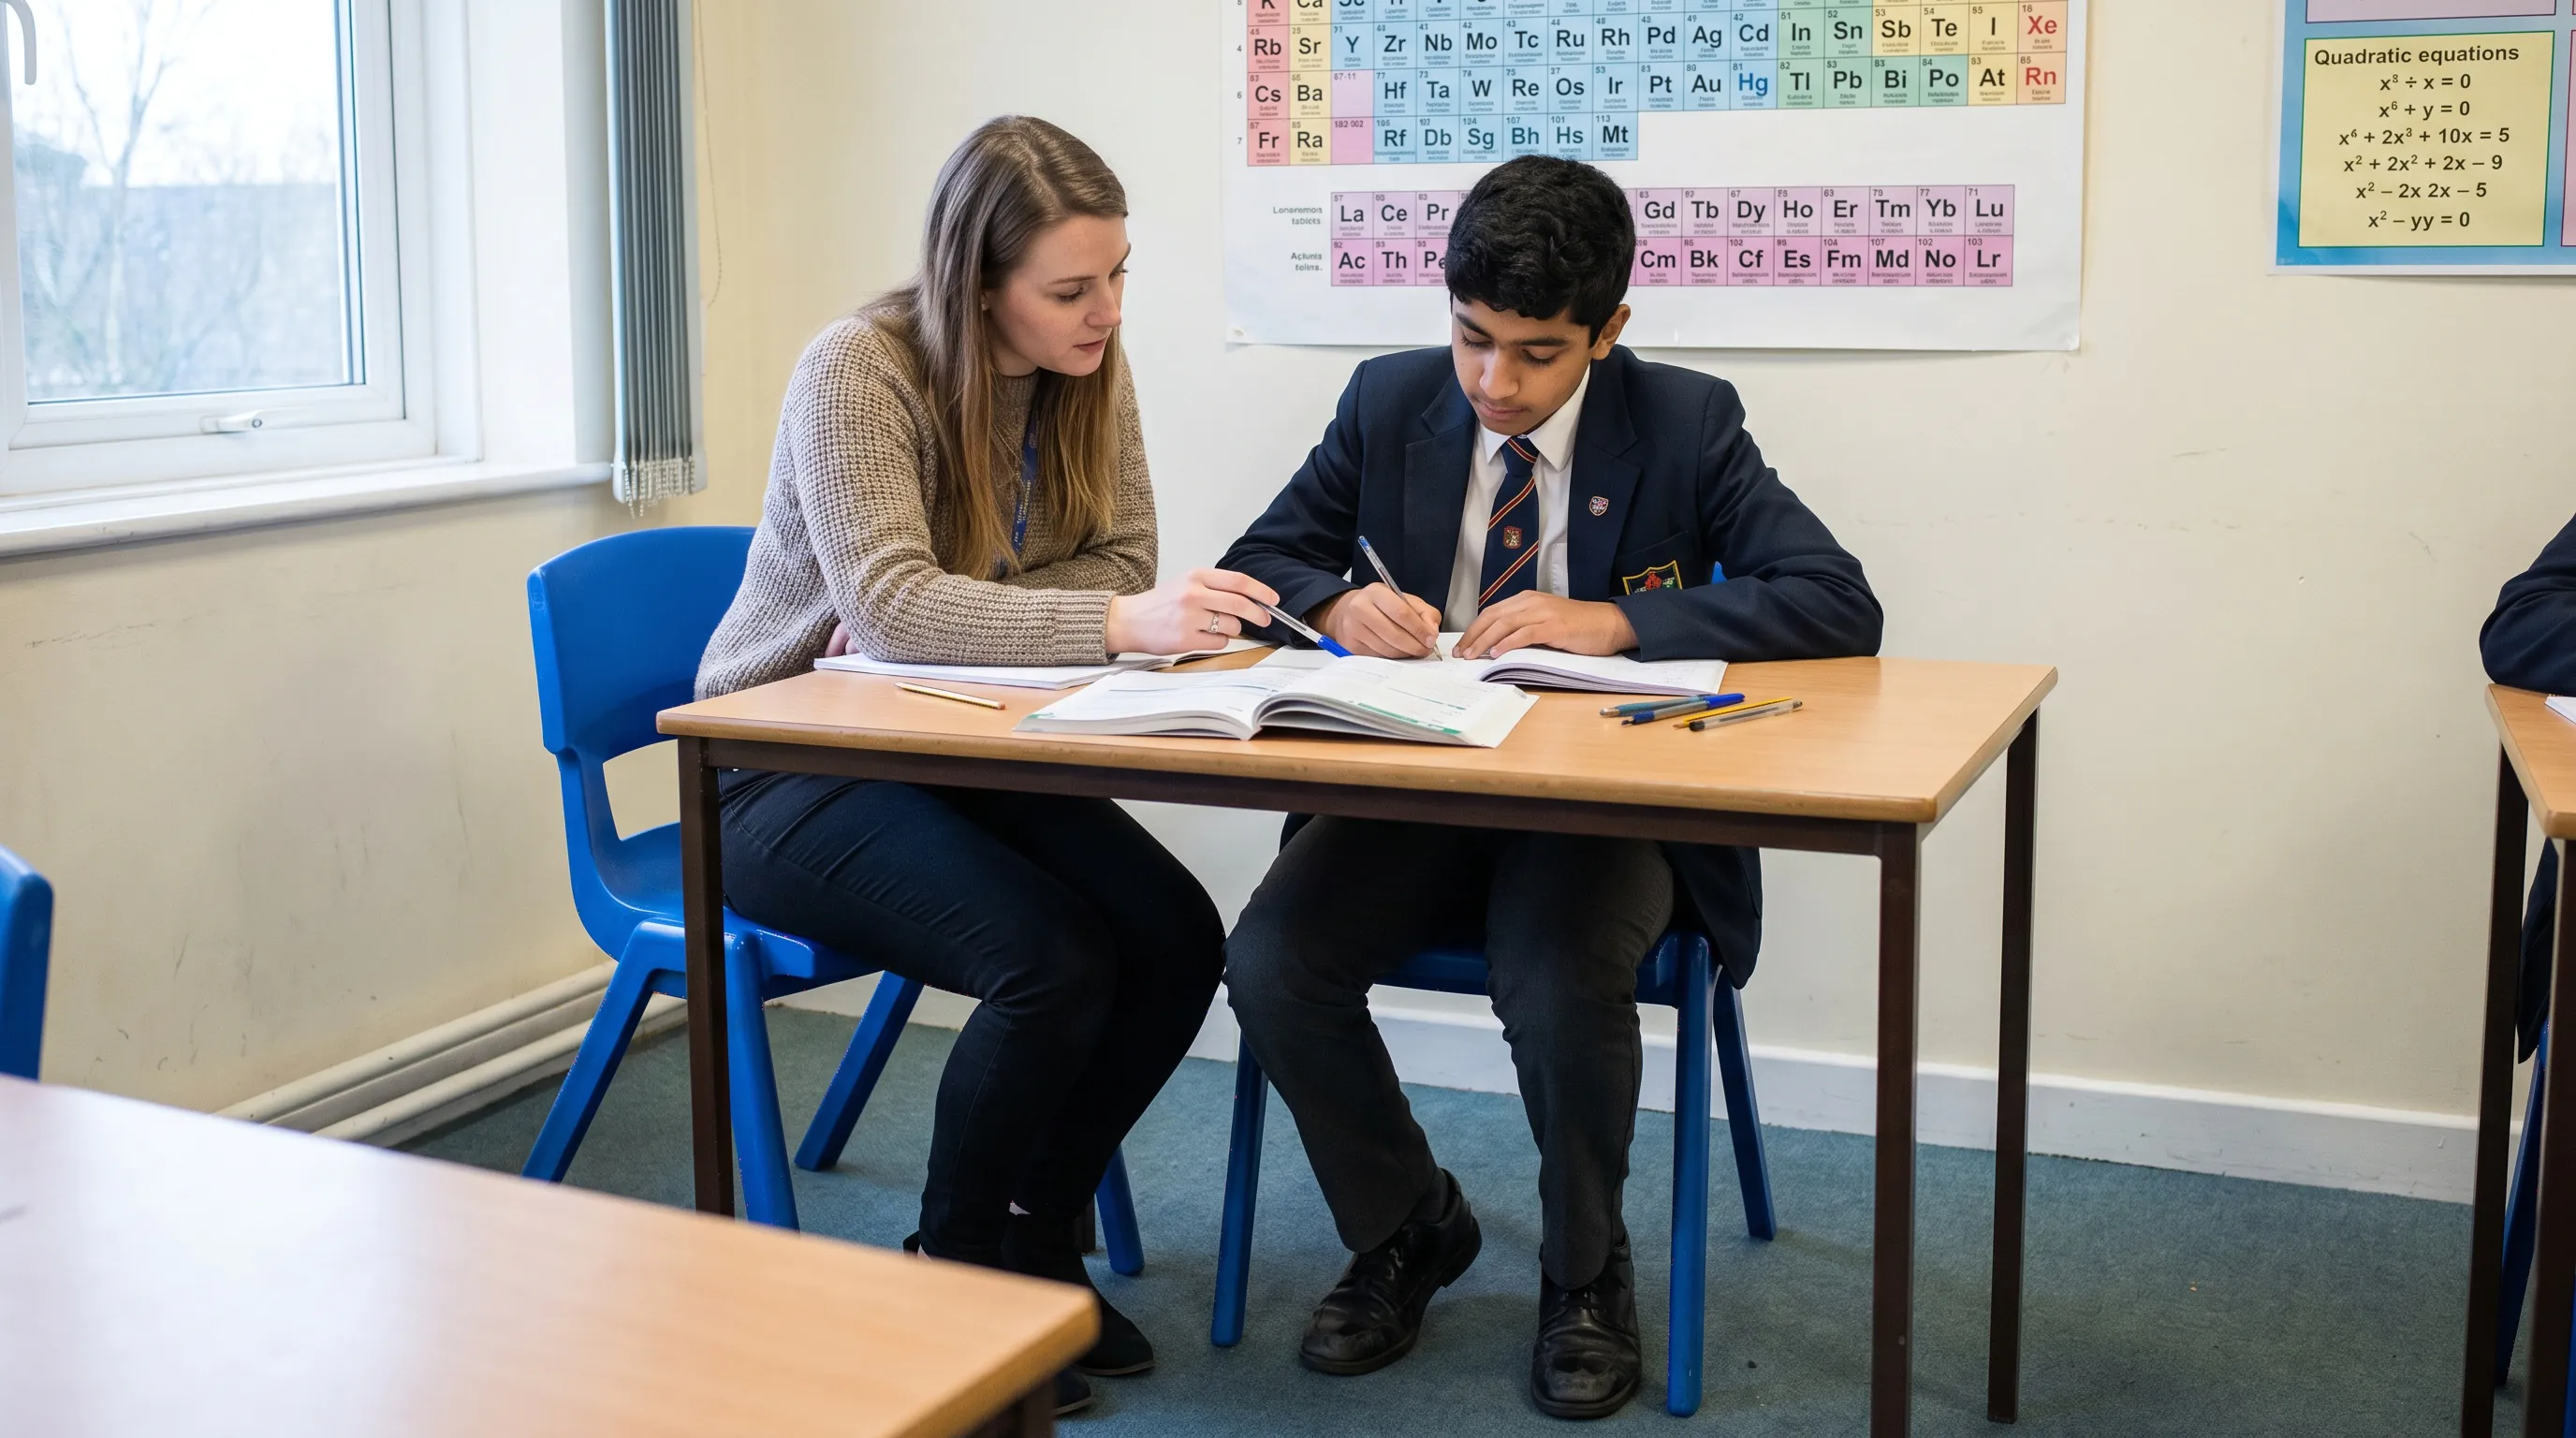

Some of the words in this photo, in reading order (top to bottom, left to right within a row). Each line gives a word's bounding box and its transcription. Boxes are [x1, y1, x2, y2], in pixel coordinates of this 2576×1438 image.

[1876, 8, 1885, 17] 53
[1254, 38, 1281, 55] Rb
[1299, 37, 1321, 54] Sr
[1346, 37, 1359, 53] Y
[1384, 36, 1406, 52] Zr
[1426, 34, 1452, 51] Nb
[1467, 33, 1497, 50] Mo
[1515, 31, 1538, 49] Tc
[1557, 30, 1584, 47] Ru
[1602, 28, 1630, 46] Rh
[1648, 26, 1675, 44] Pd
[1692, 26, 1721, 48] Ag
[1739, 24, 1768, 42] Cd
[1793, 23, 1810, 41] In
[1834, 22, 1862, 39] Sn
[1881, 20, 1910, 37] Sb
[1931, 19, 1957, 37] Te
[1992, 17, 1996, 36] I
[2027, 16, 2056, 35] Xe
[1875, 59, 1884, 67] 83
[1922, 58, 1932, 66] 84
[2315, 48, 2411, 66] Quadratic
[2419, 46, 2519, 66] equations
[1255, 85, 1281, 102] Cs
[1298, 85, 1323, 101] Ba
[1385, 81, 1407, 99] Hf
[1427, 81, 1449, 98] Ta
[1471, 80, 1491, 96] W
[1513, 79, 1539, 96] Re
[1557, 78, 1584, 95] Os
[1609, 77, 1623, 94] Ir
[1650, 76, 1672, 93] Pt
[1691, 75, 1720, 93] Au
[1739, 73, 1768, 96] Hg
[1790, 72, 1809, 90] Tl
[1834, 71, 1862, 89] Pb
[1885, 70, 1906, 88] Bi
[1930, 69, 1958, 87] Po
[1980, 68, 2005, 86] At
[2026, 67, 2056, 85] Rn
[2406, 77, 2417, 88] ÷
[2423, 79, 2434, 89] x
[2461, 74, 2470, 88] 0
[2405, 105, 2416, 115] +
[2422, 106, 2434, 121] y
[2460, 101, 2469, 115] 0
[1259, 132, 1280, 149] Fr
[1297, 131, 1322, 148] Ra
[1384, 129, 1406, 146] Rf
[1425, 129, 1451, 146] Db
[1468, 128, 1494, 150] Sg
[1512, 127, 1539, 144] Bh
[1557, 126, 1583, 143] Hs
[1603, 125, 1628, 143] Mt
[2364, 132, 2375, 142] +
[2420, 131, 2430, 141] +
[2439, 128, 2472, 143] 10x
[2499, 127, 2510, 142] 5
[2369, 159, 2380, 169] +
[2425, 158, 2436, 169] +
[2443, 155, 2466, 170] 2x
[2492, 154, 2502, 169] 9
[1969, 188, 1978, 197] 71
[2399, 183, 2421, 198] 2x
[2428, 183, 2450, 198] 2x
[2477, 183, 2486, 197] 5
[1341, 205, 1364, 222] La
[1382, 205, 1407, 222] Ce
[1427, 204, 1449, 221] Pr
[1645, 201, 1675, 219] Gd
[1691, 201, 1719, 218] Tb
[1737, 200, 1765, 223] Dy
[1784, 200, 1813, 218] Ho
[1835, 200, 1858, 217] Er
[1876, 199, 1910, 217] Tm
[1926, 199, 1956, 217] Yb
[1976, 199, 2003, 217] Lu
[2411, 216, 2434, 231] yy
[2460, 212, 2469, 227] 0
[1339, 252, 1365, 269] Ac
[1382, 252, 1406, 269] Th
[1641, 250, 1676, 268] Cm
[1690, 250, 1719, 268] Bk
[1739, 250, 1764, 268] Cf
[1785, 250, 1810, 268] Es
[1828, 250, 1861, 268] Fm
[1876, 250, 1909, 268] Md
[1925, 250, 1955, 268] No
[1977, 250, 2000, 267] Lr
